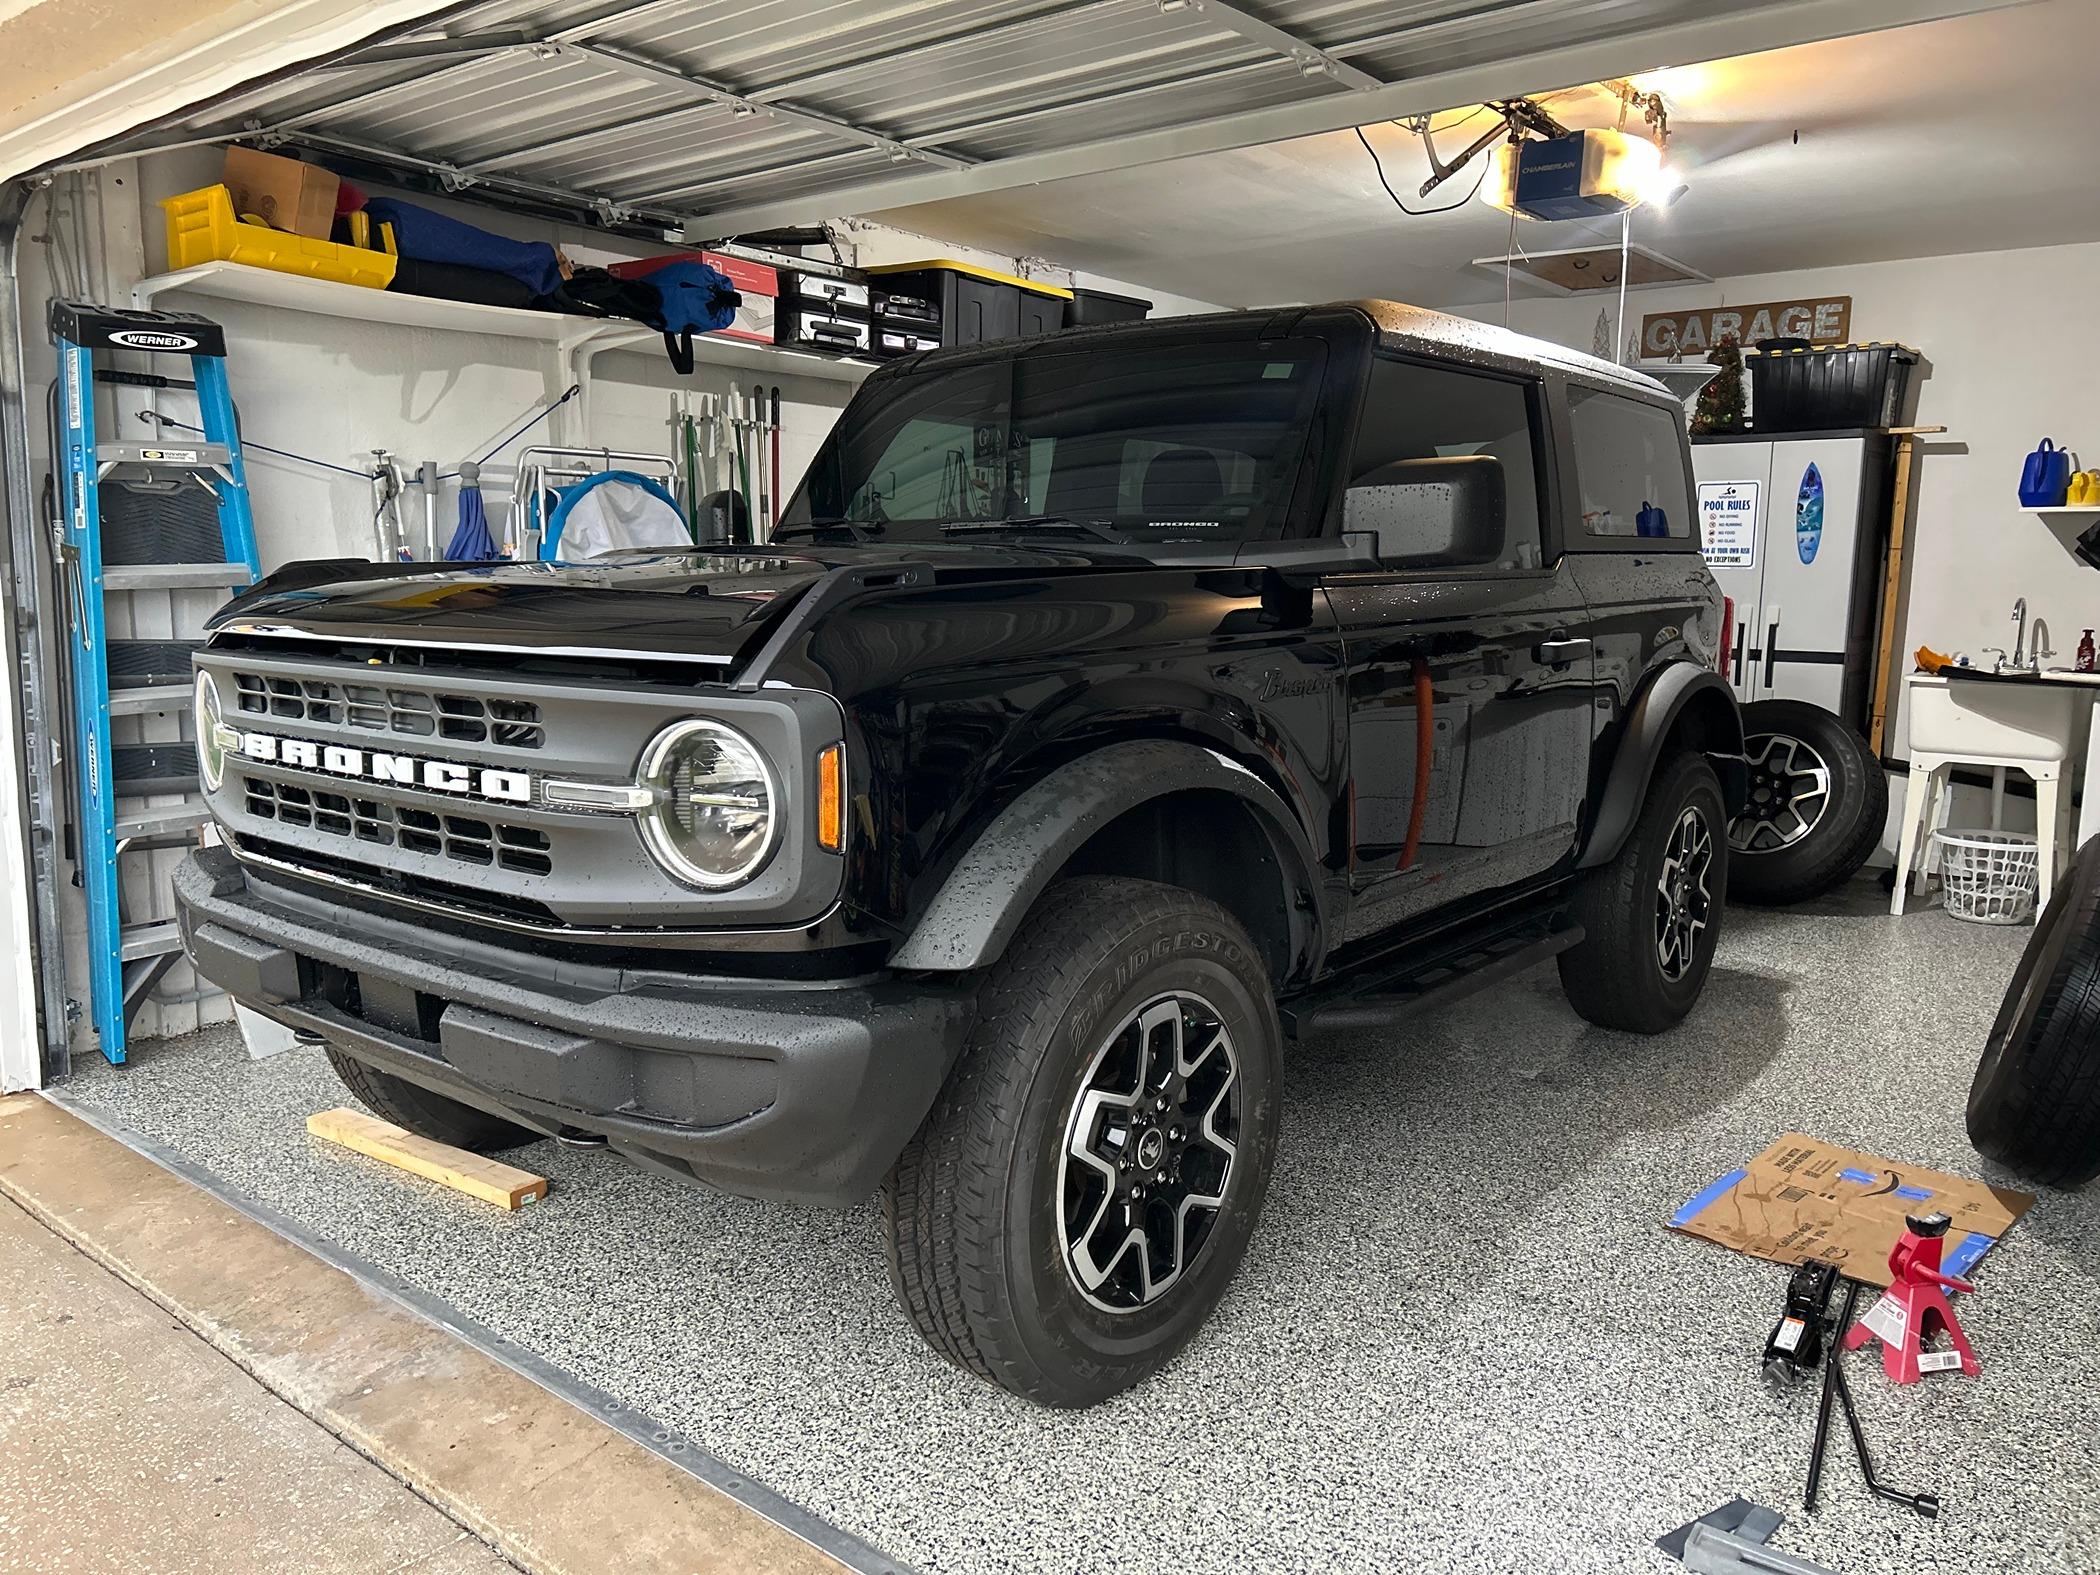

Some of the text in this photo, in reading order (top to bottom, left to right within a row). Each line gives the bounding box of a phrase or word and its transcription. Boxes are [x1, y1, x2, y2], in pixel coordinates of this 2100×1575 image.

[1521, 161, 1577, 174] CHAMBERLAIN
[1646, 303, 1844, 352] GARAGE
[127, 334, 182, 346] WERNER
[1704, 500, 1751, 511] POOL RULES
[244, 733, 530, 801] BRONCO
